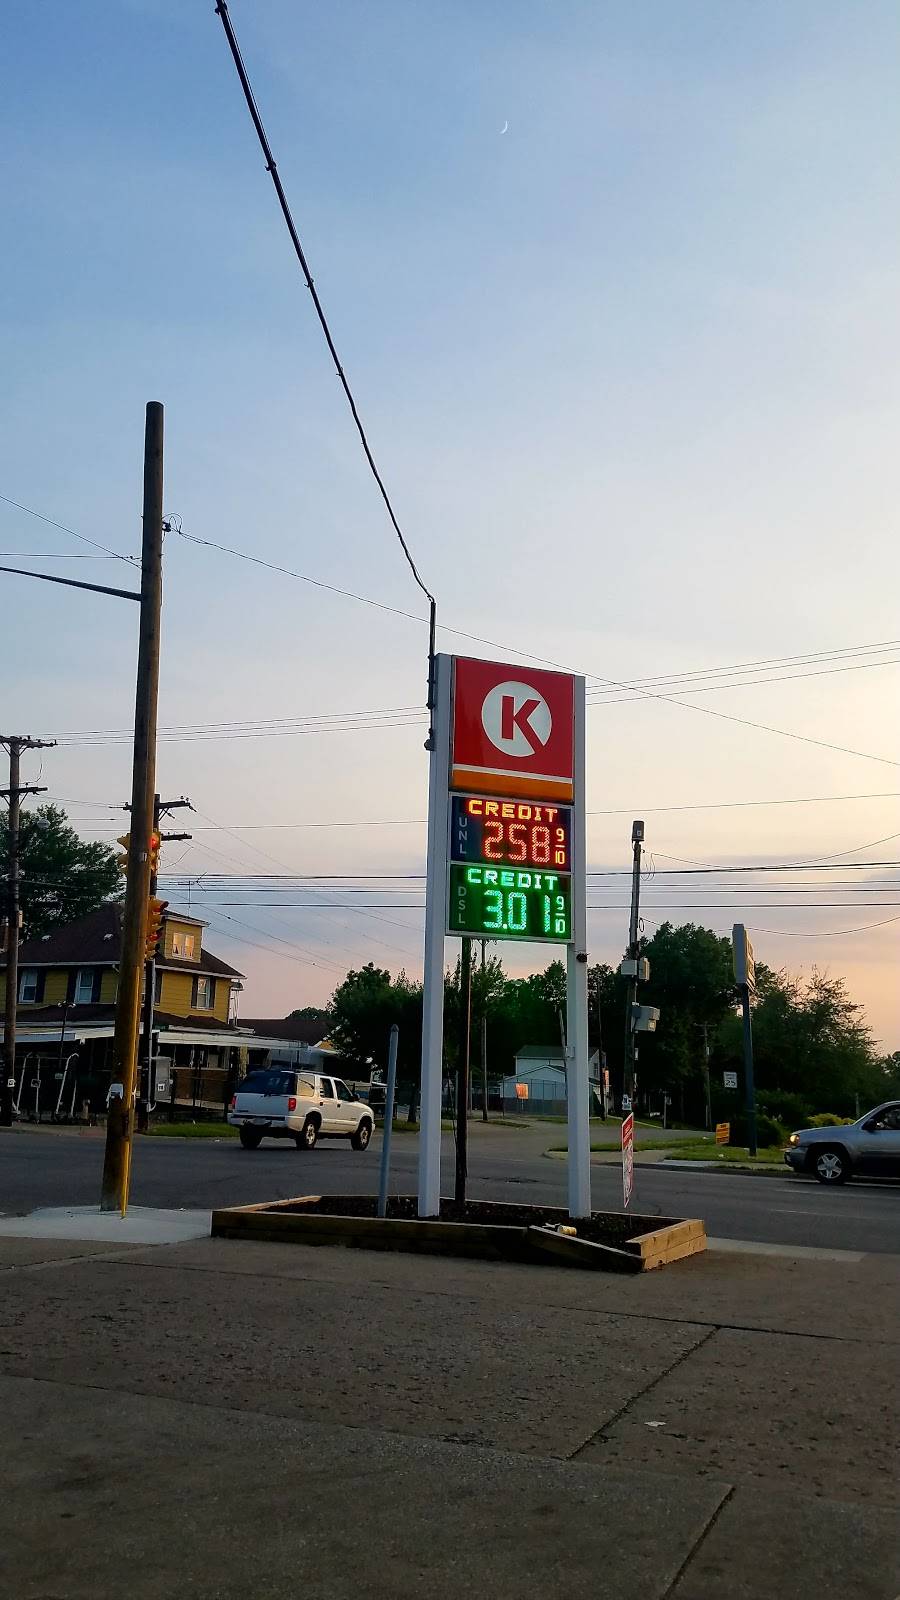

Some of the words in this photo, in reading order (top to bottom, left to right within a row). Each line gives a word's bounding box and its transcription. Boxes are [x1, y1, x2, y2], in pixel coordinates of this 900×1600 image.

[468, 799, 558, 823] CREDIT
[458, 816, 468, 855] UNL
[484, 820, 550, 863] 258
[467, 868, 558, 891] CREDIT
[457, 886, 467, 924] DSL
[483, 889, 551, 933] 3.01
